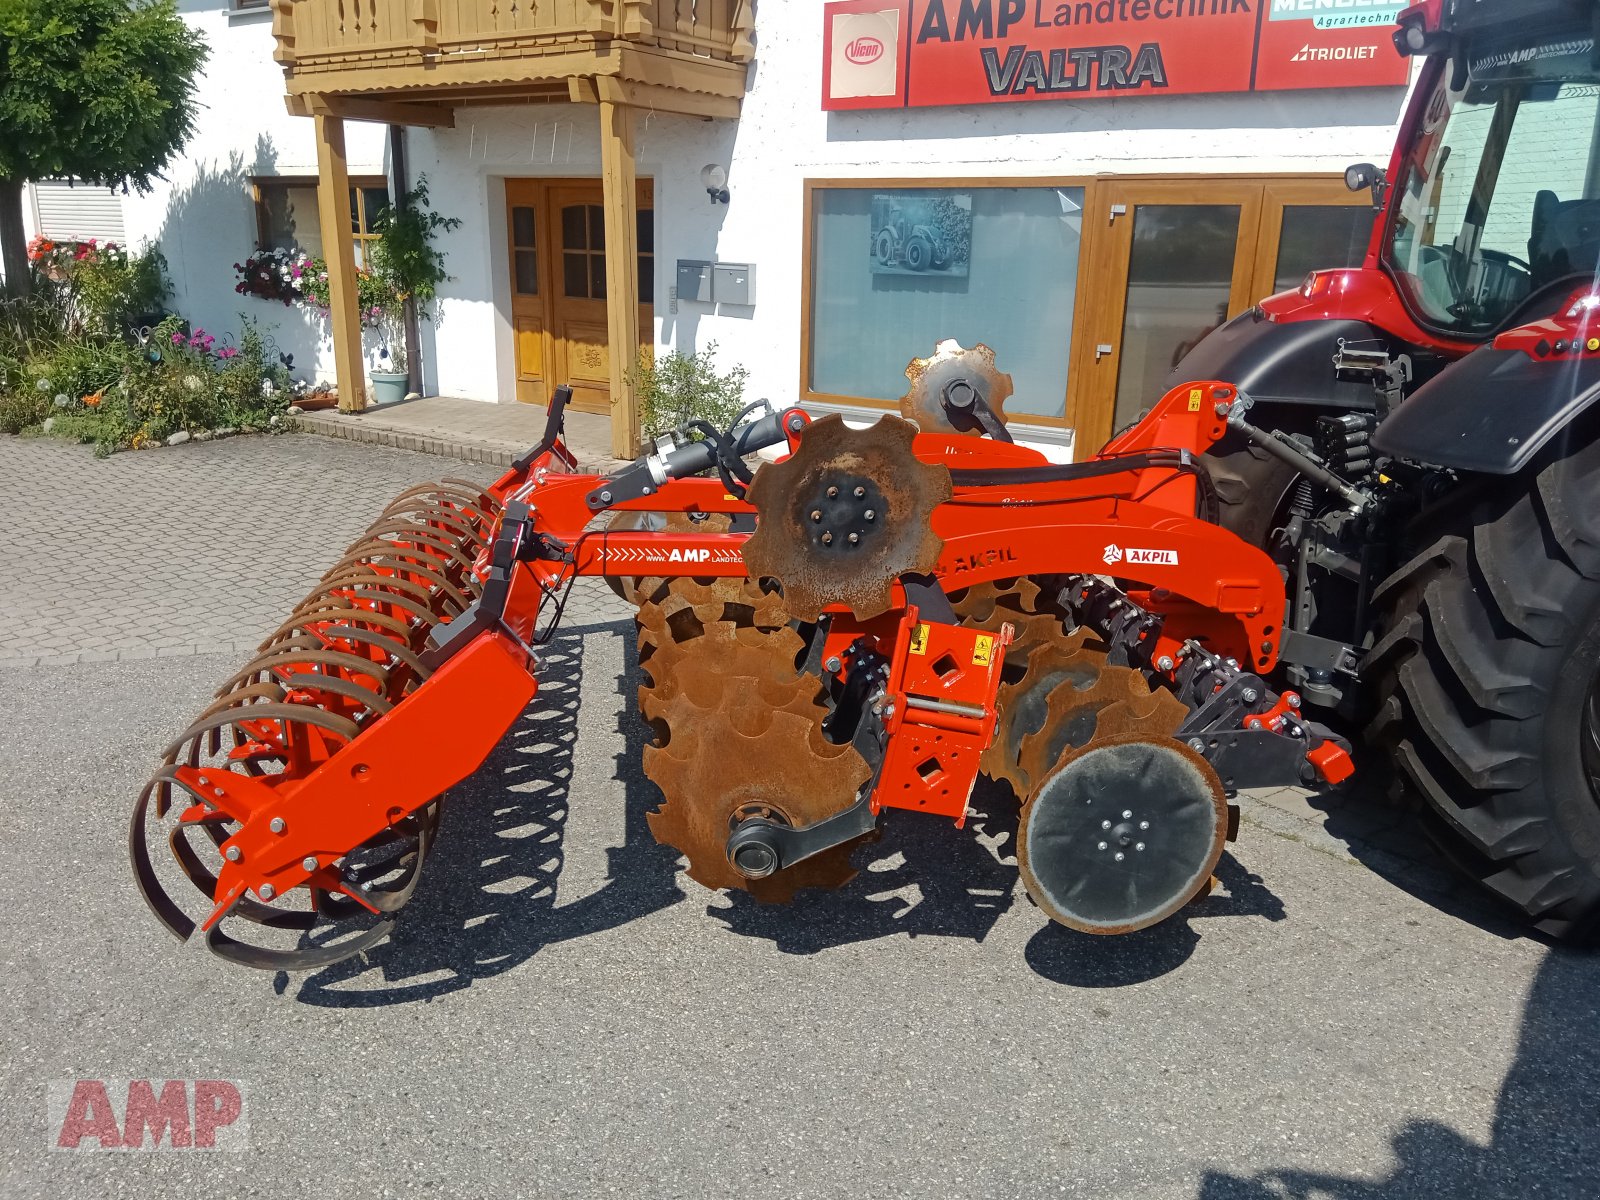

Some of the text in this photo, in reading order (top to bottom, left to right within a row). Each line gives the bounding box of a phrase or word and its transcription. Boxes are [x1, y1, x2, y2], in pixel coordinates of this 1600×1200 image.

[916, 0, 1025, 44] AMP
[1317, 12, 1396, 27] Agrartechni
[850, 40, 878, 57] Vicon
[1309, 46, 1377, 61] TRIOLIET
[980, 43, 1168, 95] VALTRA
[955, 547, 1017, 574] AKPIL
[1131, 550, 1171, 563] AKPIL
